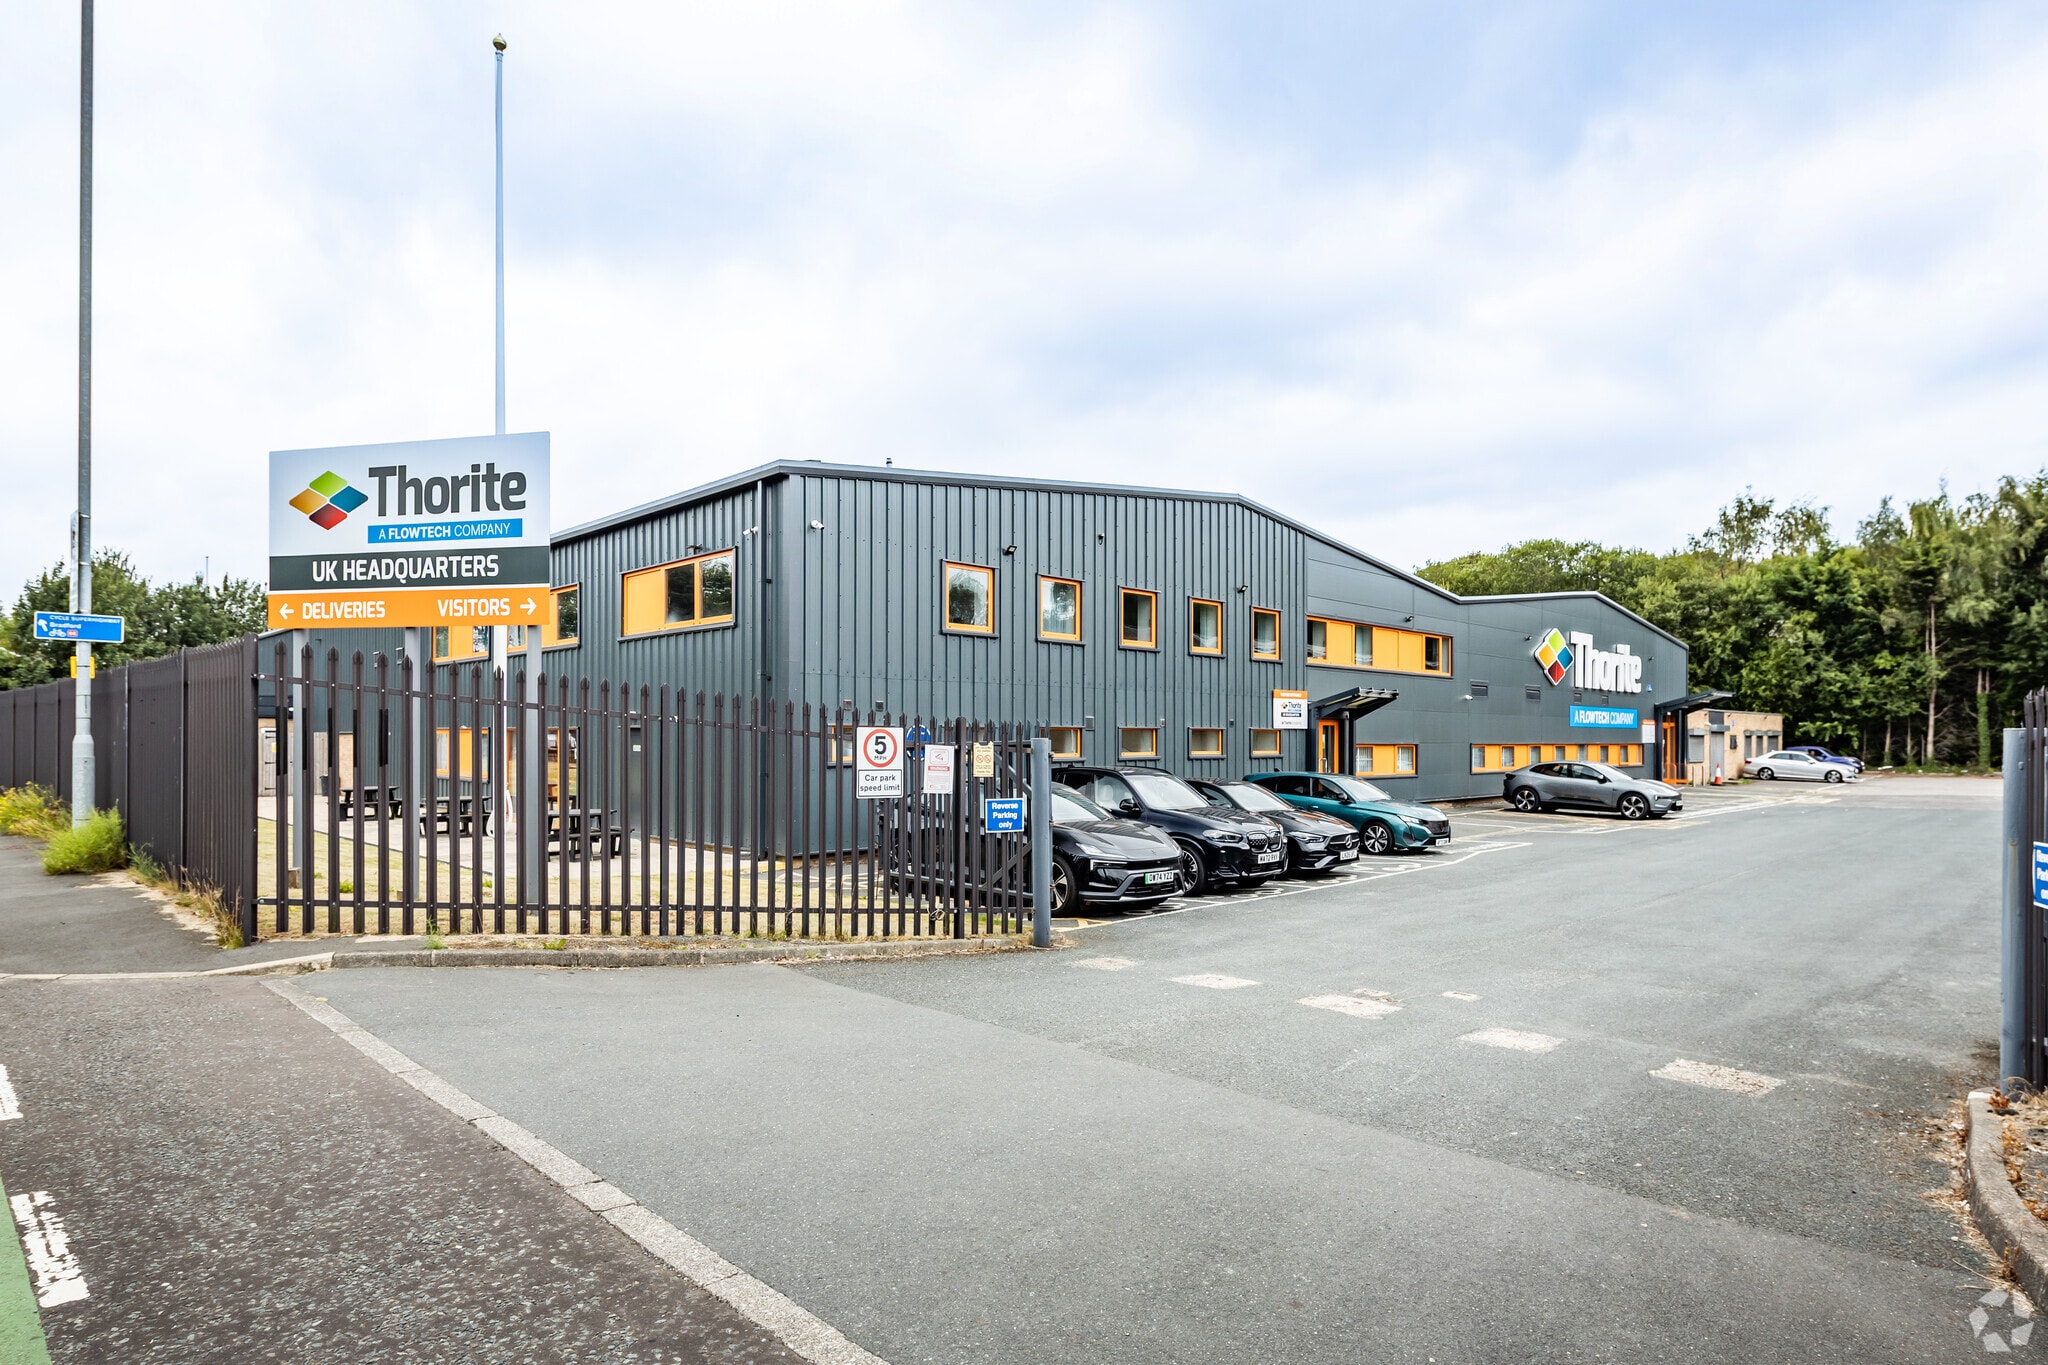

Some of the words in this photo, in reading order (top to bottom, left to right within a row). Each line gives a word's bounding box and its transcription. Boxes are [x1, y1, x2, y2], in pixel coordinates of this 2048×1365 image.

[368, 462, 527, 517] Thorite
[378, 528, 387, 540] A
[388, 525, 451, 540] FLOWTECH
[454, 522, 511, 537] COMPANY
[312, 560, 338, 582] UK
[343, 554, 499, 583] HEADQUARTERS
[302, 600, 386, 620] DELIVERIES
[437, 597, 510, 617] VISITORS
[1570, 631, 1642, 693] Thorite
[1574, 709, 1579, 724] A
[1580, 710, 1610, 725] FLOWTECH
[1610, 712, 1634, 725] COMPANY
[874, 735, 887, 755] 5
[880, 774, 896, 783] park
[860, 784, 882, 792] speed
[991, 802, 1019, 810] Reverse
[992, 811, 1018, 820] Parking
[998, 820, 1013, 829] only
